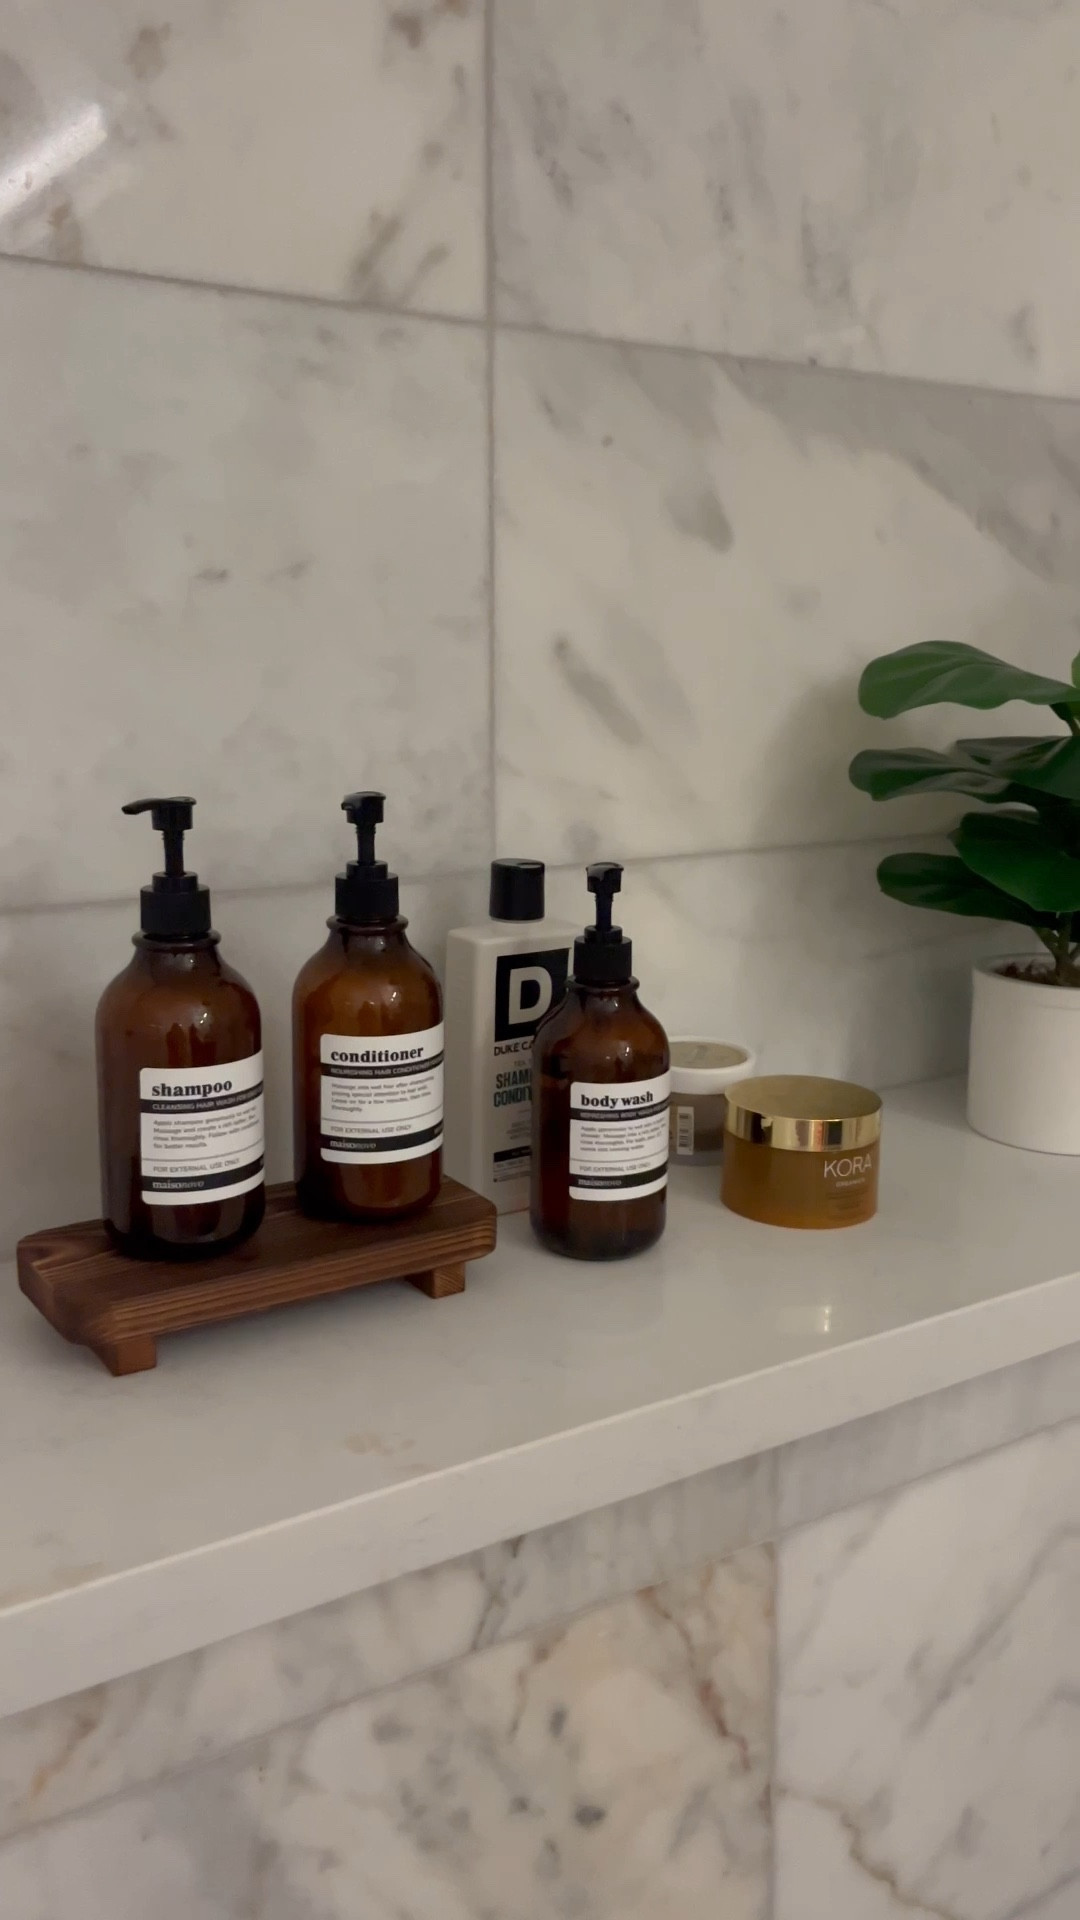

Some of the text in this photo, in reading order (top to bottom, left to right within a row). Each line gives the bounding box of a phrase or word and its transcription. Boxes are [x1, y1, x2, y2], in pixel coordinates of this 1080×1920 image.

[508, 966, 553, 1025] D
[330, 1047, 424, 1063] conditioner
[493, 1042, 520, 1056] DUKE
[495, 1068, 533, 1090] SHAM
[151, 1081, 233, 1097] shampoo
[152, 1103, 195, 1111] CLEANSING
[196, 1101, 215, 1110] HAIR
[581, 1094, 619, 1109] body
[620, 1090, 654, 1107] wash
[345, 1126, 380, 1134] EXTERNAL
[381, 1125, 395, 1133] USE
[395, 1124, 412, 1132] ONLY
[169, 1164, 208, 1174] EXTERNAL
[209, 1160, 223, 1170] USE
[224, 1158, 241, 1168] ONLY
[824, 1154, 872, 1178] KORA
[152, 1179, 206, 1190] maisonovo
